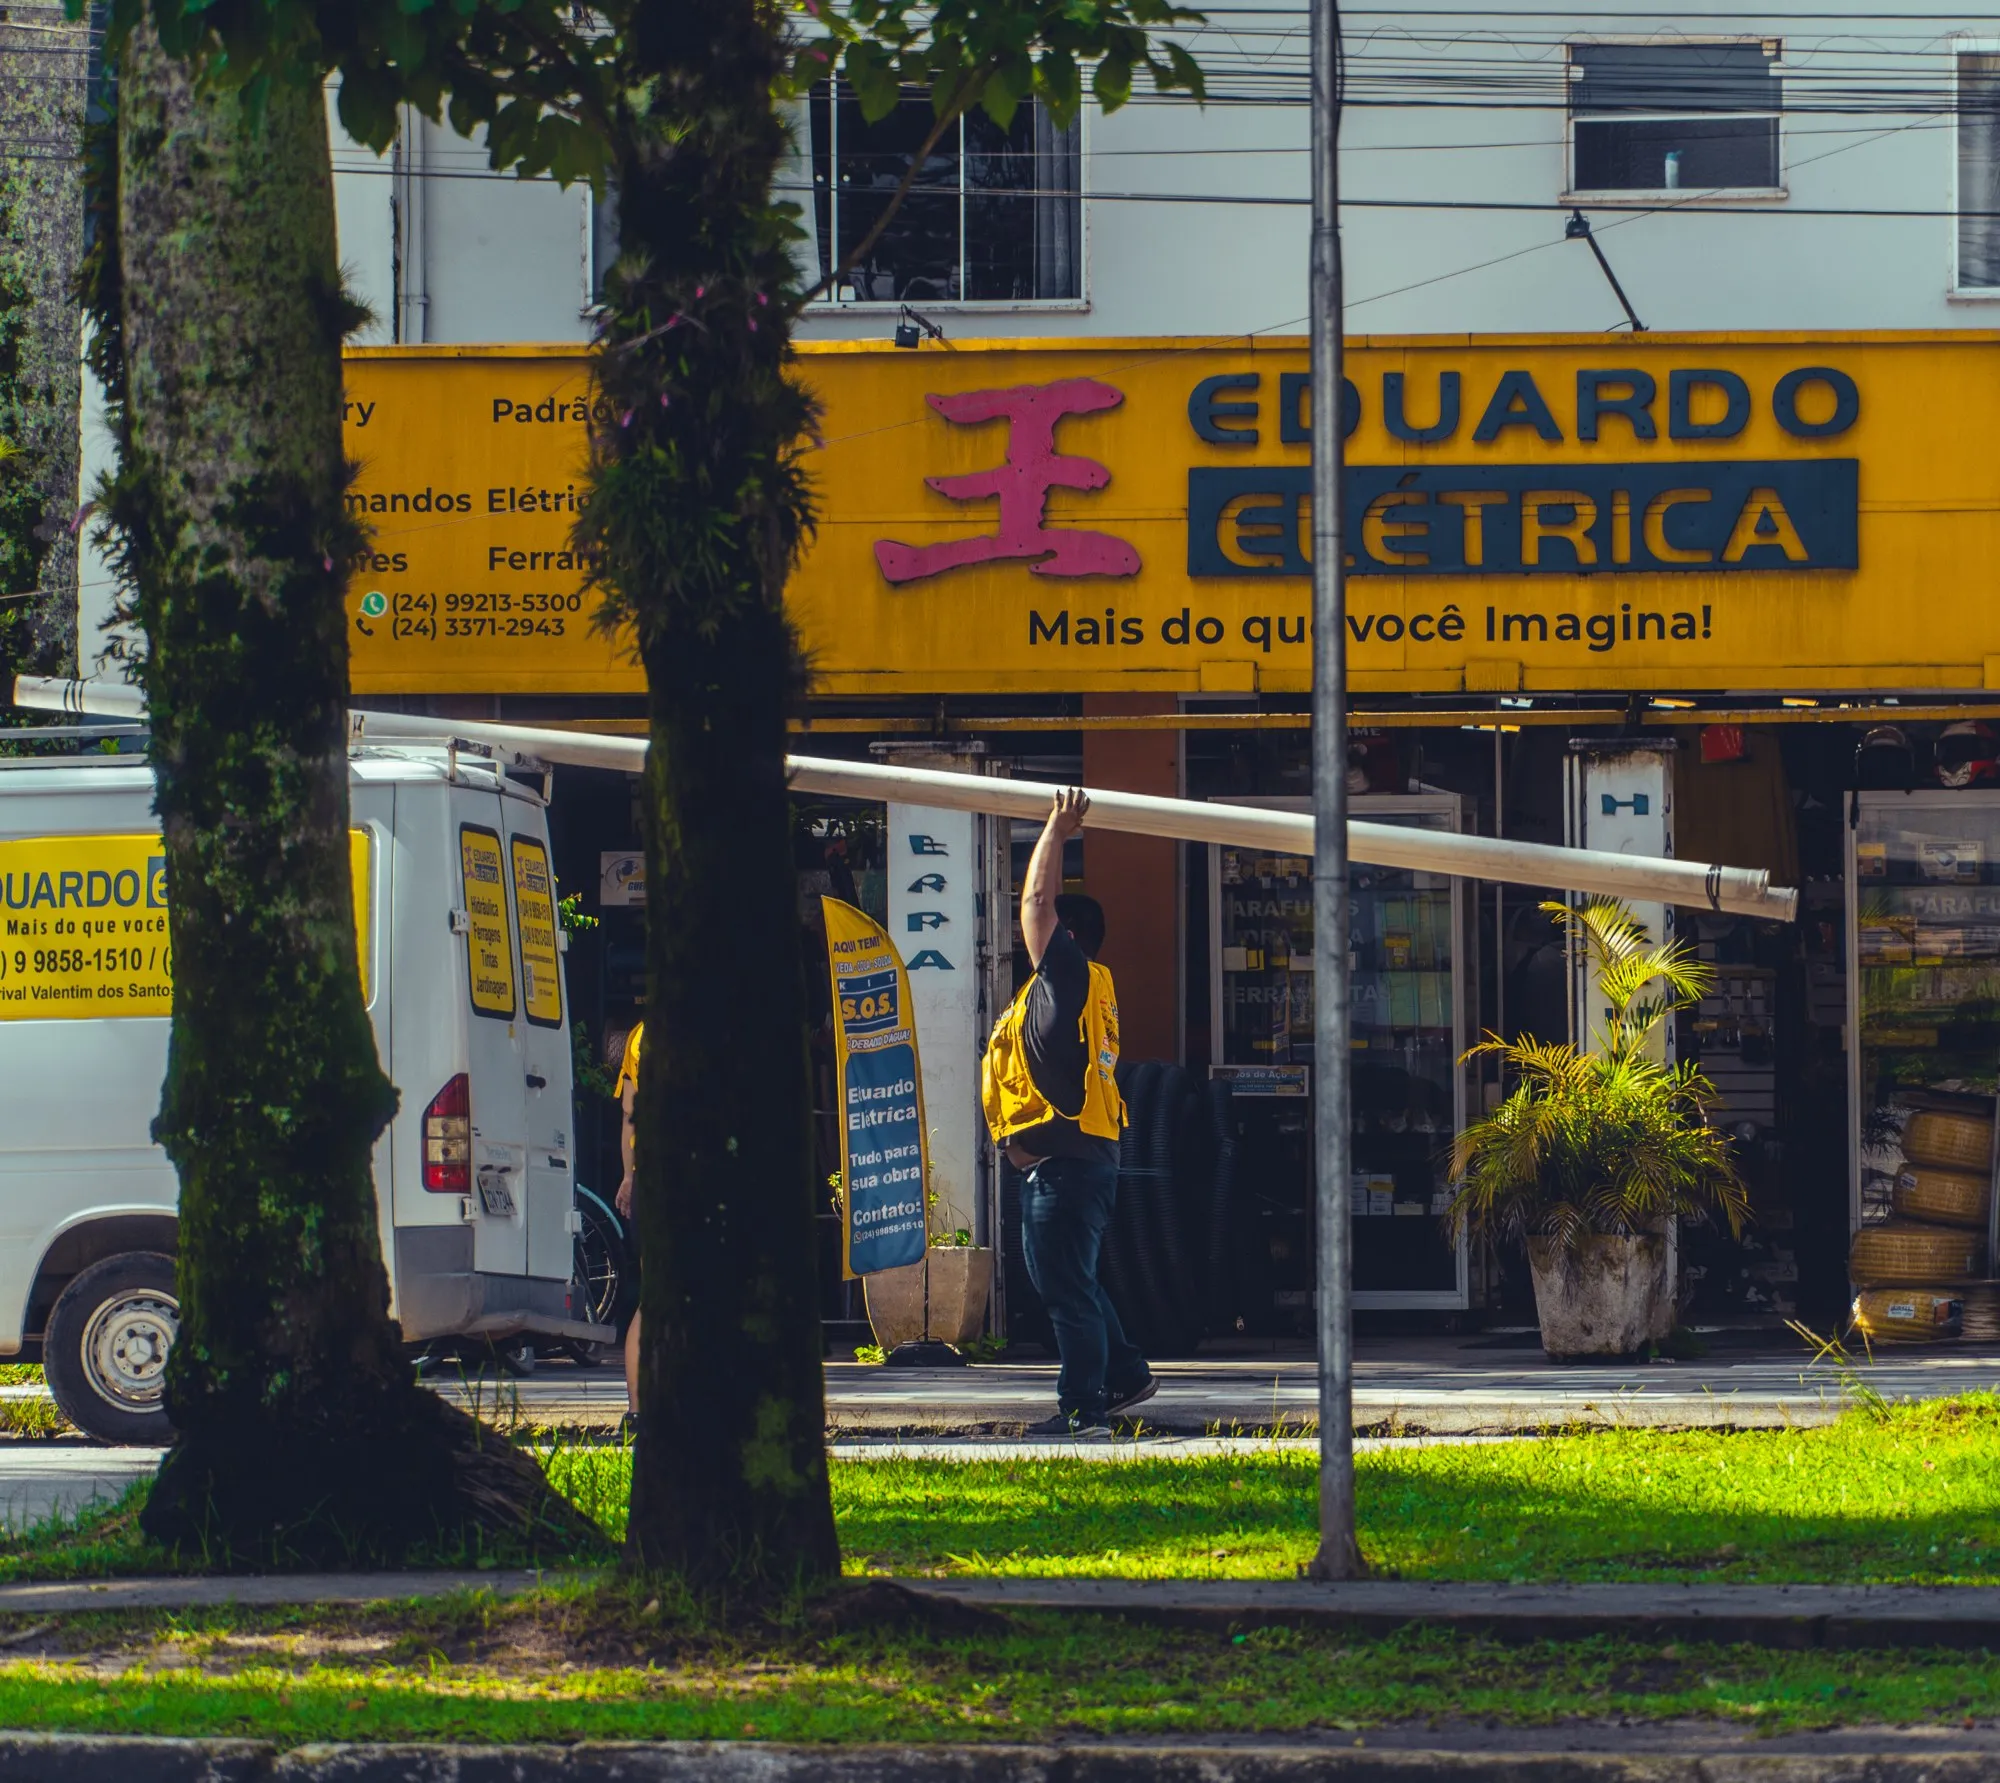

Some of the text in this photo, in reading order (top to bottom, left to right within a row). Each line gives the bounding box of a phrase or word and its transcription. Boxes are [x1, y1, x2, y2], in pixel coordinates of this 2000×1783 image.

[1188, 366, 1859, 444] EDUARDO
[392, 593, 581, 617] (24) 99213-5300
[392, 618, 565, 641] (24) 3371-2943
[1028, 604, 1713, 652] Mais do qu você Imagina!
[0, 869, 140, 909] UARDO
[7, 916, 165, 938] Mais do que você
[833, 936, 880, 953] AQUI TEM!
[14, 950, 26, 973] 9
[34, 948, 142, 974] 9858-1510
[31, 984, 93, 1000] Valentim
[97, 983, 124, 999] dos
[841, 993, 894, 1021] S.O.S.
[850, 1143, 919, 1168] Tudo para
[851, 1165, 921, 1191] sua obra
[853, 1201, 922, 1226] Contato:
